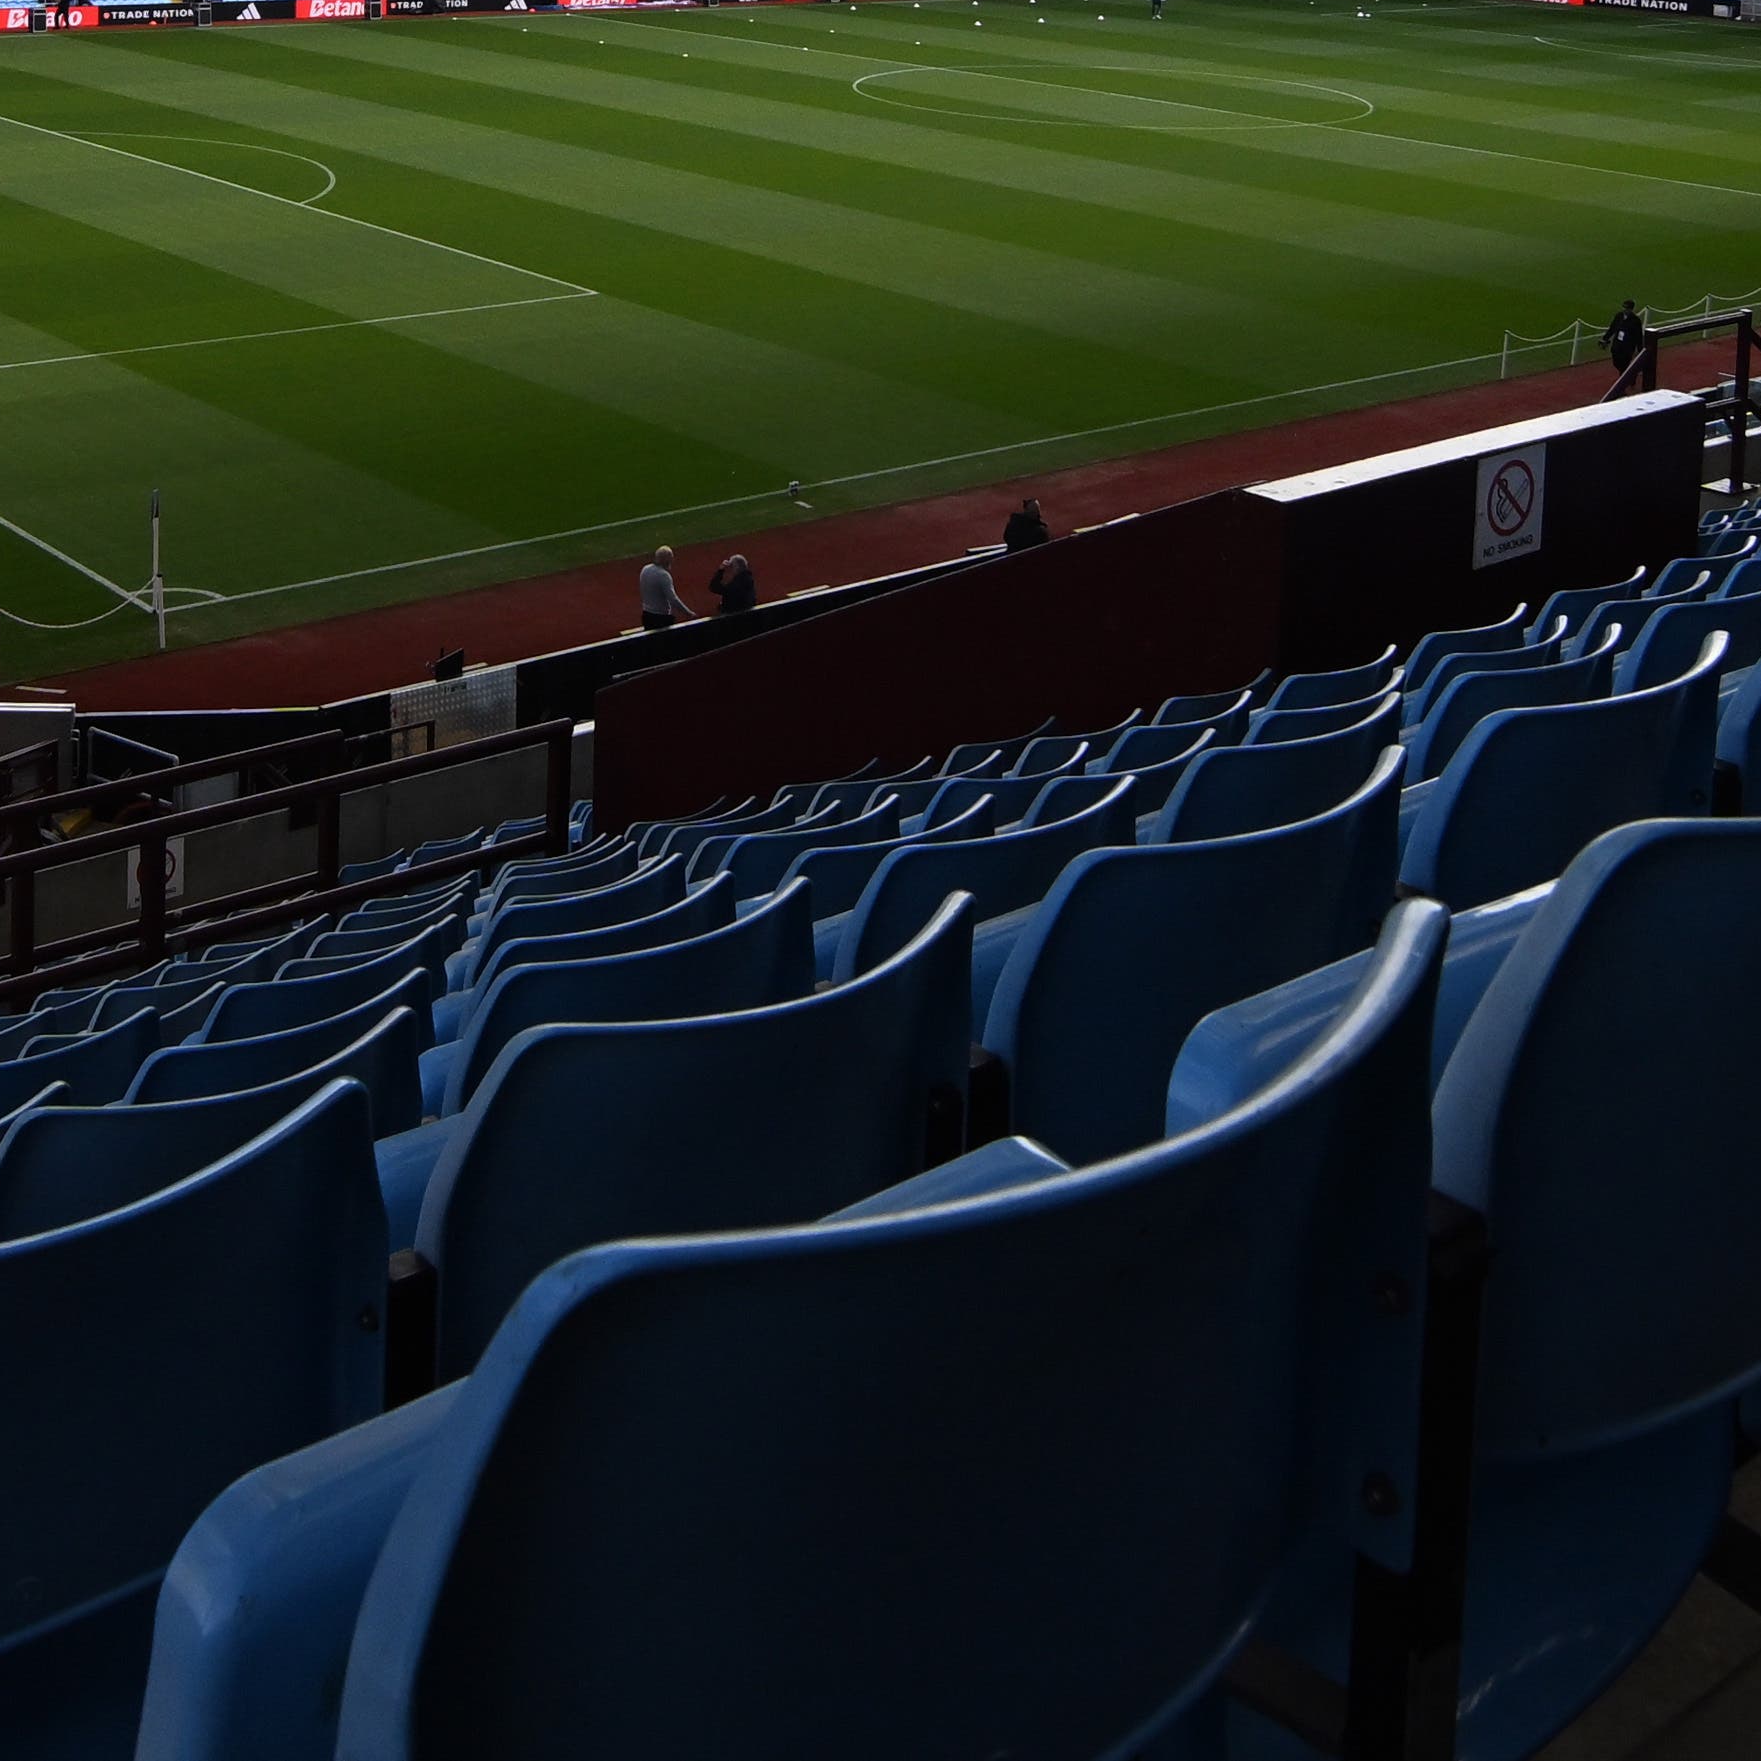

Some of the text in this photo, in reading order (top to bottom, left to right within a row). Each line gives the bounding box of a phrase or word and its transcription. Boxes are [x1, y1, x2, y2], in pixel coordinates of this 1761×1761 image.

[397, 1, 424, 10] TRAD
[1641, 0, 1688, 13] NATION
[111, 11, 150, 21] TRADE
[1483, 533, 1534, 558] NO SMOKING
